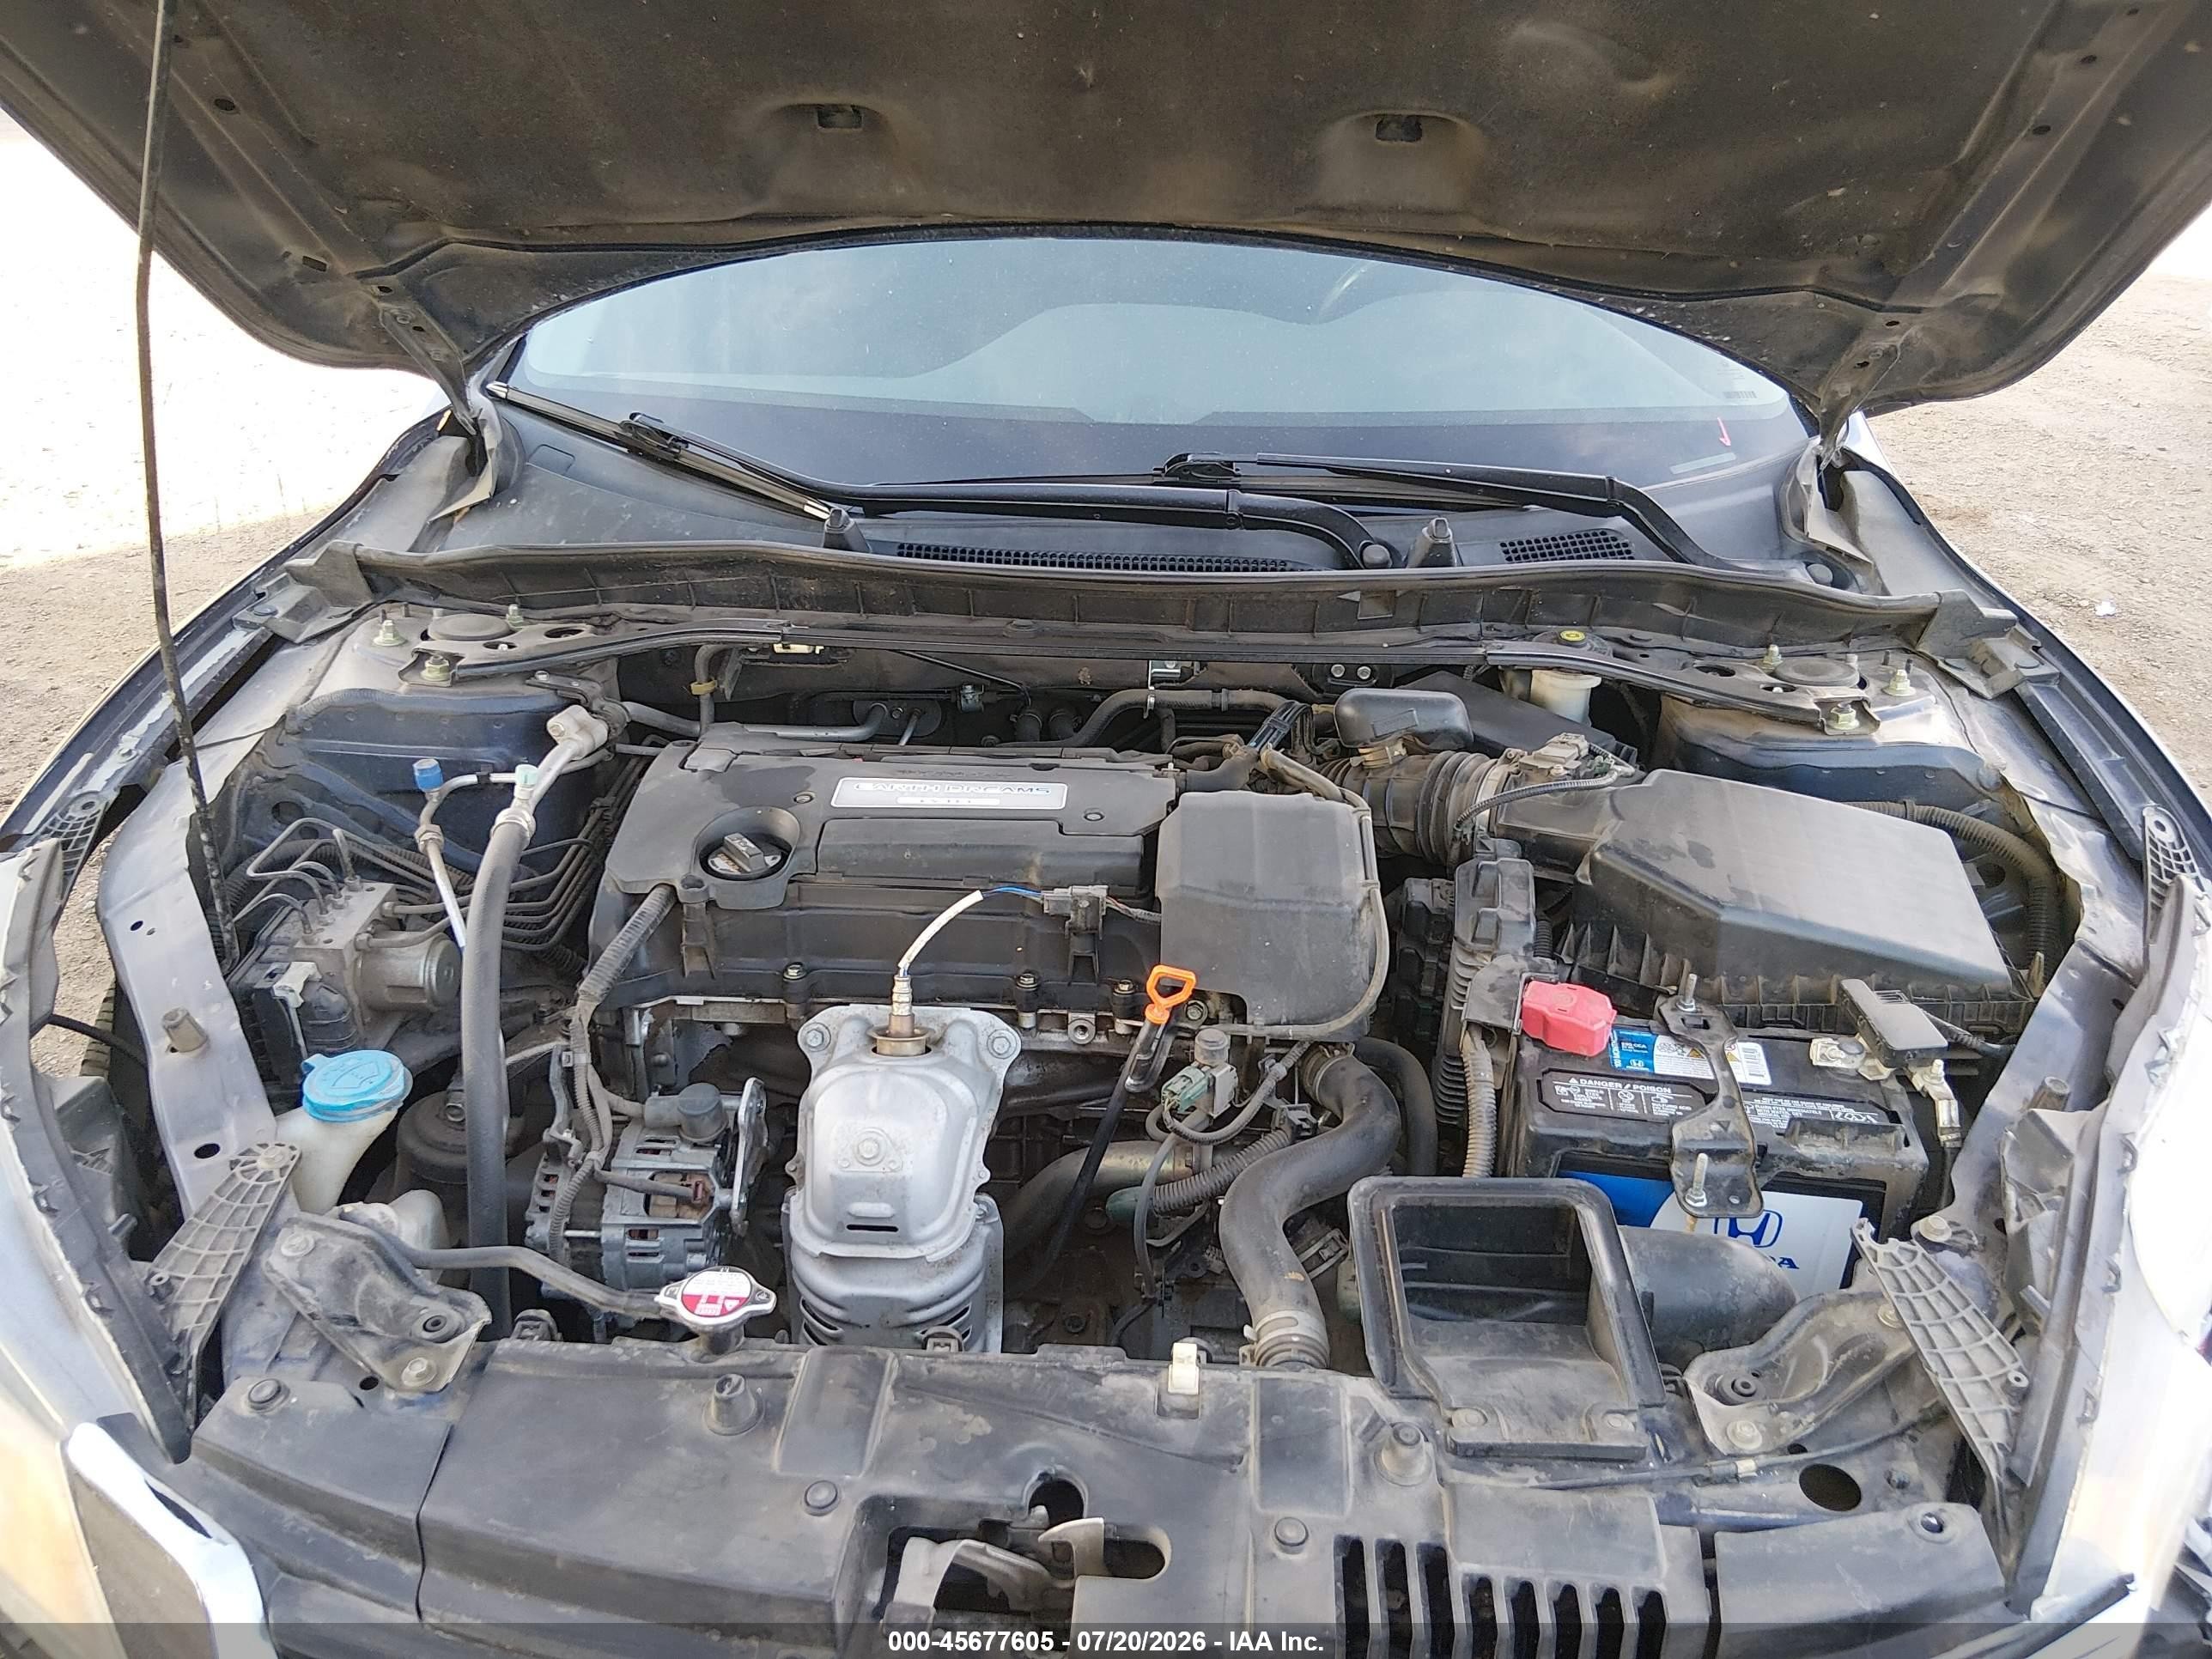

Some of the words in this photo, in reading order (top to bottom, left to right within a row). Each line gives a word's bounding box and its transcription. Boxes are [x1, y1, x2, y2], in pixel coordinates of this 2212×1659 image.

[945, 784, 1052, 794] DREAMS
[1579, 1079, 1622, 1089] DANGER
[1632, 1085, 1672, 1093] POISON
